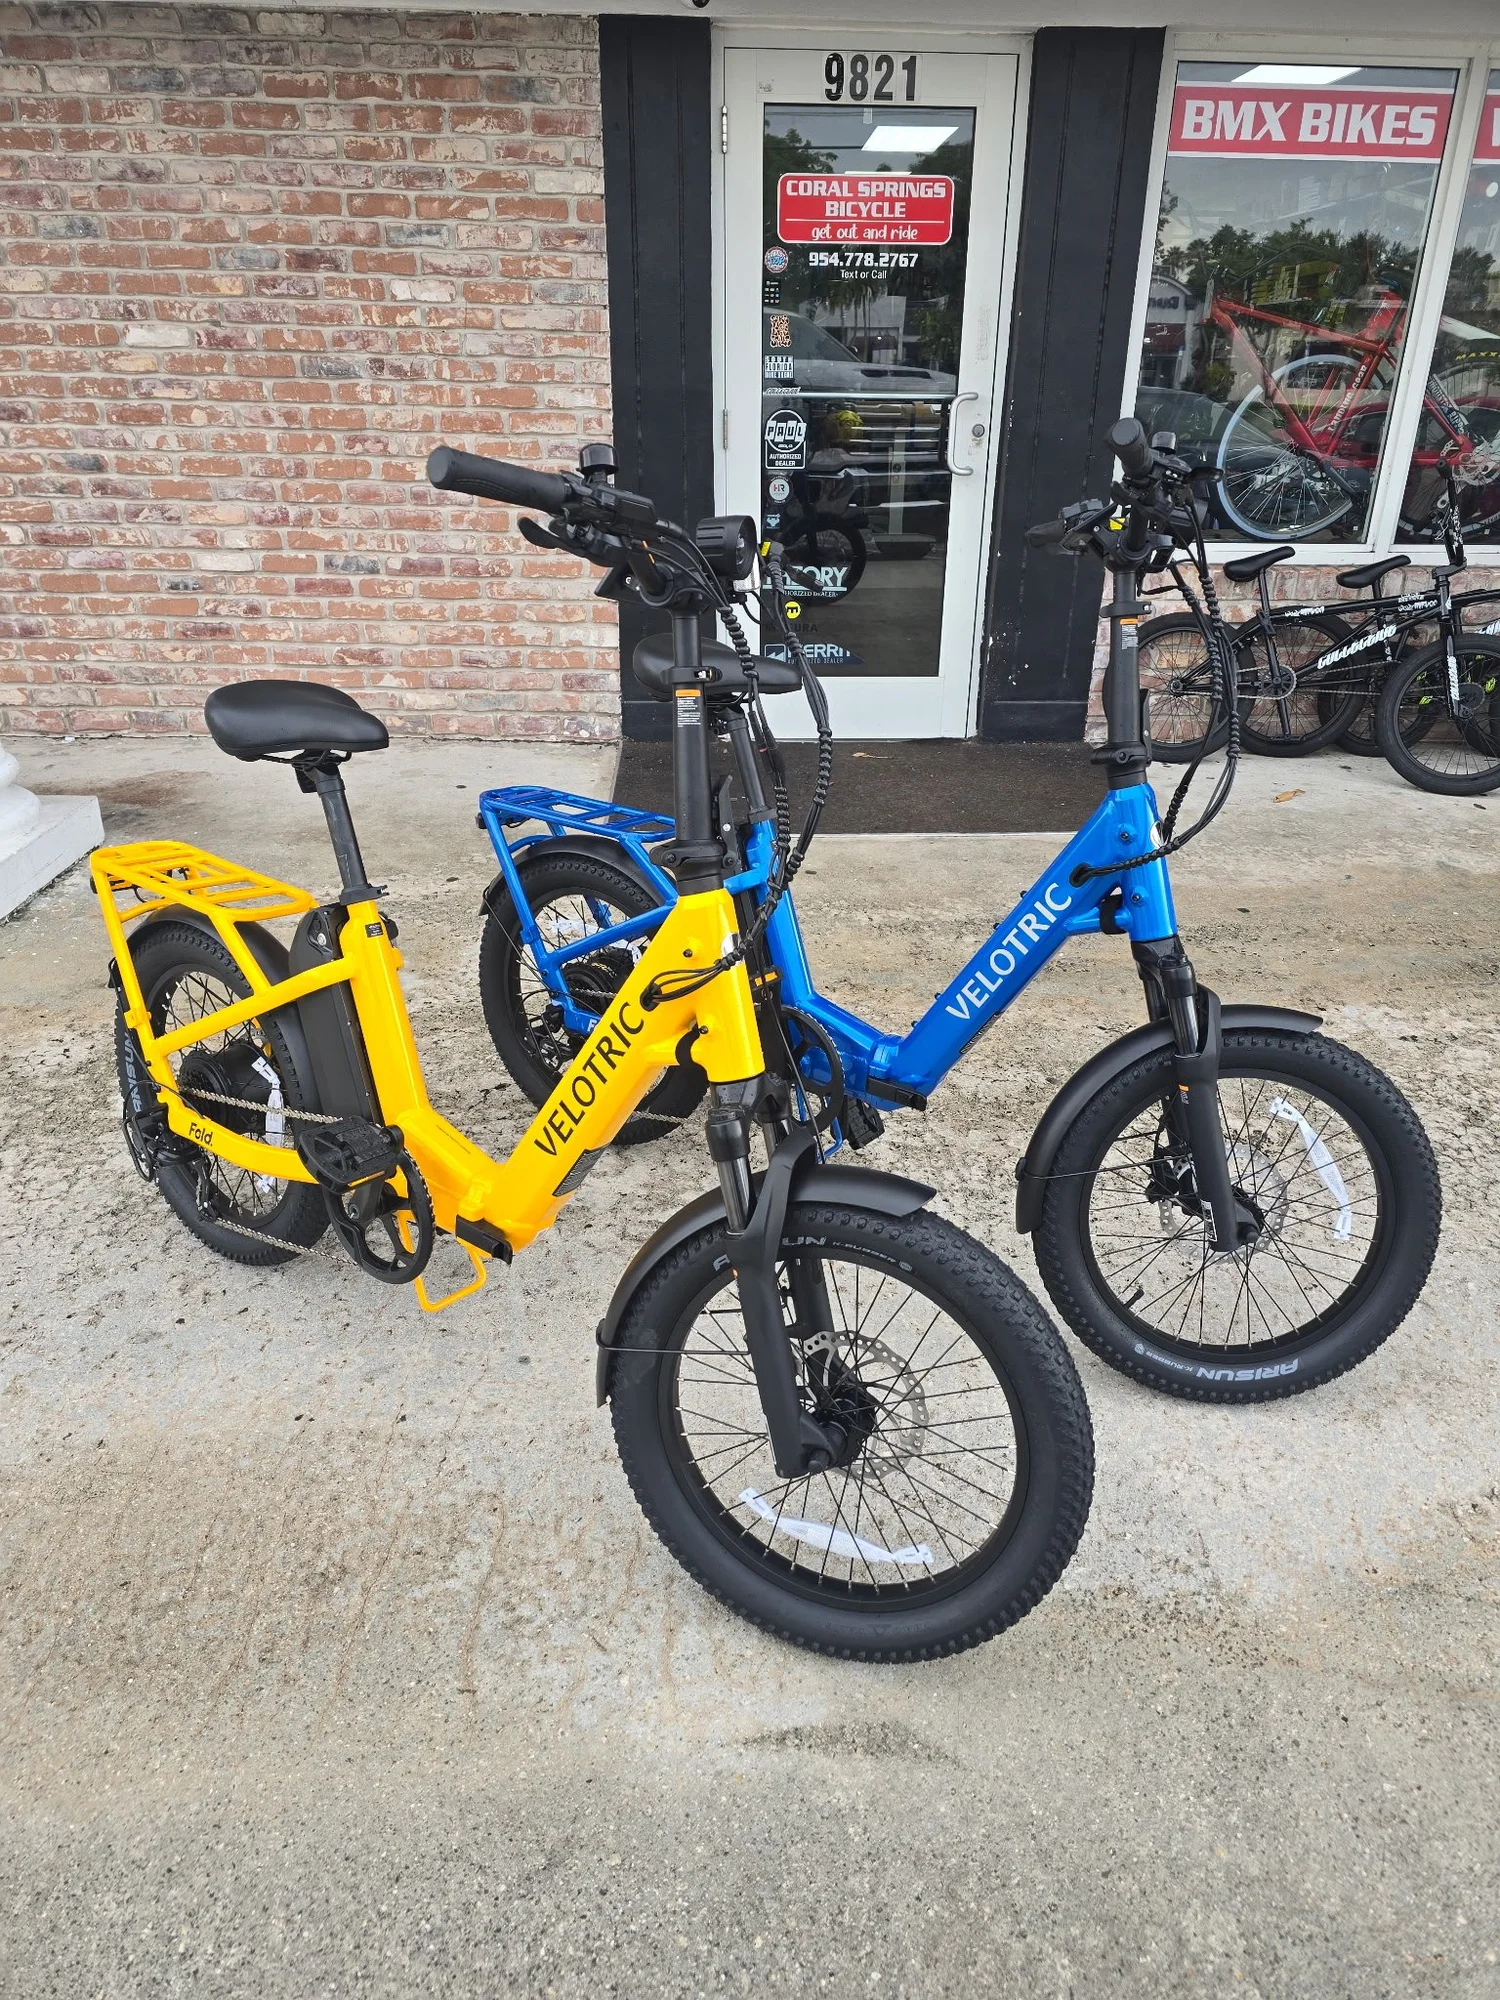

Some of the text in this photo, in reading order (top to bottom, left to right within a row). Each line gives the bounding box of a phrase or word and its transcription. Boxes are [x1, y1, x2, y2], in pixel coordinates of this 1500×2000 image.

[824, 52, 918, 101] 9821
[1180, 99, 1292, 143] BMX
[1297, 101, 1438, 146] BIKES
[786, 179, 946, 199] CORAL SPRINGS
[824, 201, 906, 218] BICYCLE
[811, 224, 918, 241] get out and ride
[808, 252, 919, 268] 954.778.2767
[840, 269, 887, 280] Text or Call
[765, 361, 793, 371] FLORIDA
[766, 422, 805, 440] PAUL
[944, 882, 1072, 1020] VELOTRIC
[123, 1032, 143, 1113] ARISUN
[533, 1001, 645, 1157] VELOTRIC
[1196, 1357, 1300, 1382] ARISUN
